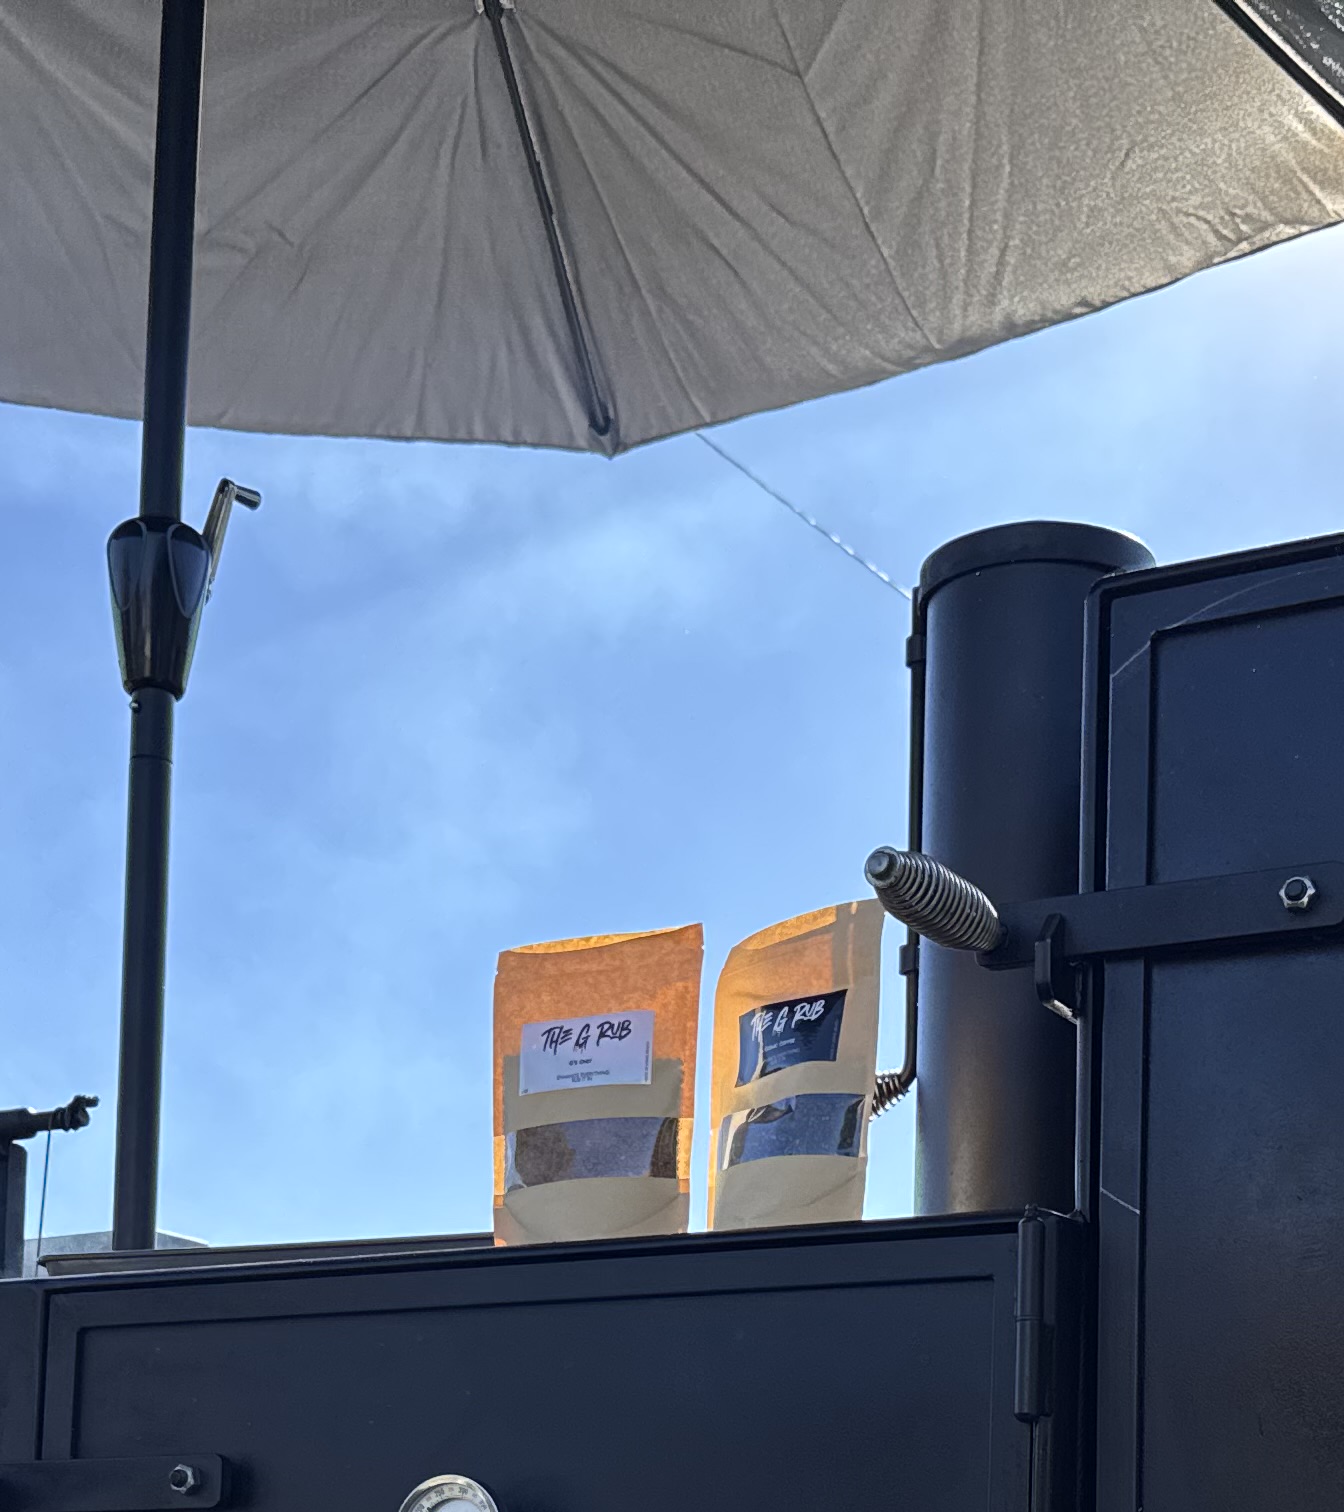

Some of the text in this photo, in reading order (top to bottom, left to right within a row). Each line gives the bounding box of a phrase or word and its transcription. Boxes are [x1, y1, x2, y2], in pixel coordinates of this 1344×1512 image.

[541, 1020, 632, 1055] THE G RUB
[750, 1000, 826, 1042] THE G RUB
